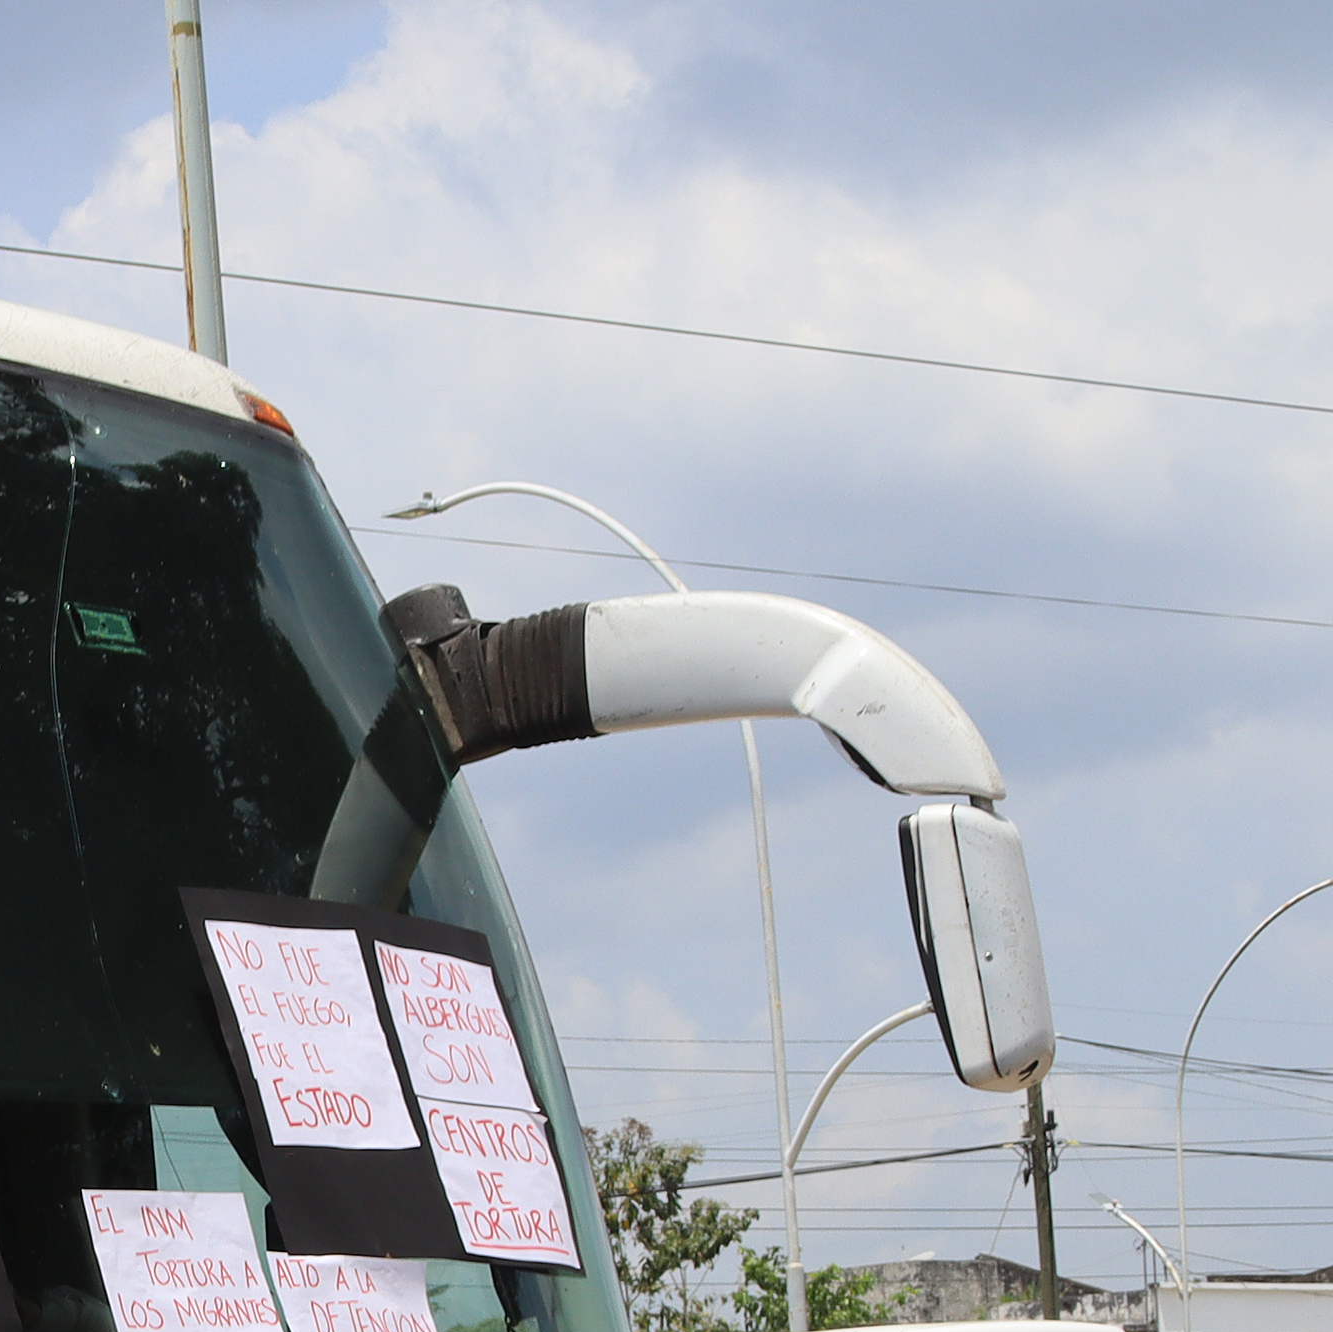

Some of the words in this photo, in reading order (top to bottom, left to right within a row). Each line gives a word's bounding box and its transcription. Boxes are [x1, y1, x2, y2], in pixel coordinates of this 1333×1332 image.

[216, 930, 263, 970] NO
[278, 941, 330, 986] FUE
[378, 945, 409, 985] NO
[420, 956, 471, 994] SON
[238, 984, 268, 1018] EL
[272, 991, 352, 1028] FUEGO,
[402, 990, 513, 1045] ALBERGUES,
[251, 1033, 294, 1070] FUE
[301, 1043, 334, 1074] EL
[422, 1033, 495, 1086] SON
[272, 1078, 373, 1129] ESTADO
[427, 1108, 550, 1166] CENTROS
[476, 1169, 512, 1206] DE
[90, 1194, 124, 1234] EL
[140, 1206, 194, 1241] INM
[453, 1201, 565, 1244] TORTURA
[135, 1249, 236, 1288] TORTURA
[244, 1260, 259, 1285] A
[276, 1258, 321, 1290] ALTO
[335, 1266, 350, 1292] A
[354, 1268, 377, 1293] LA
[117, 1292, 164, 1330] LOS
[173, 1295, 281, 1328] MIGRANTES
